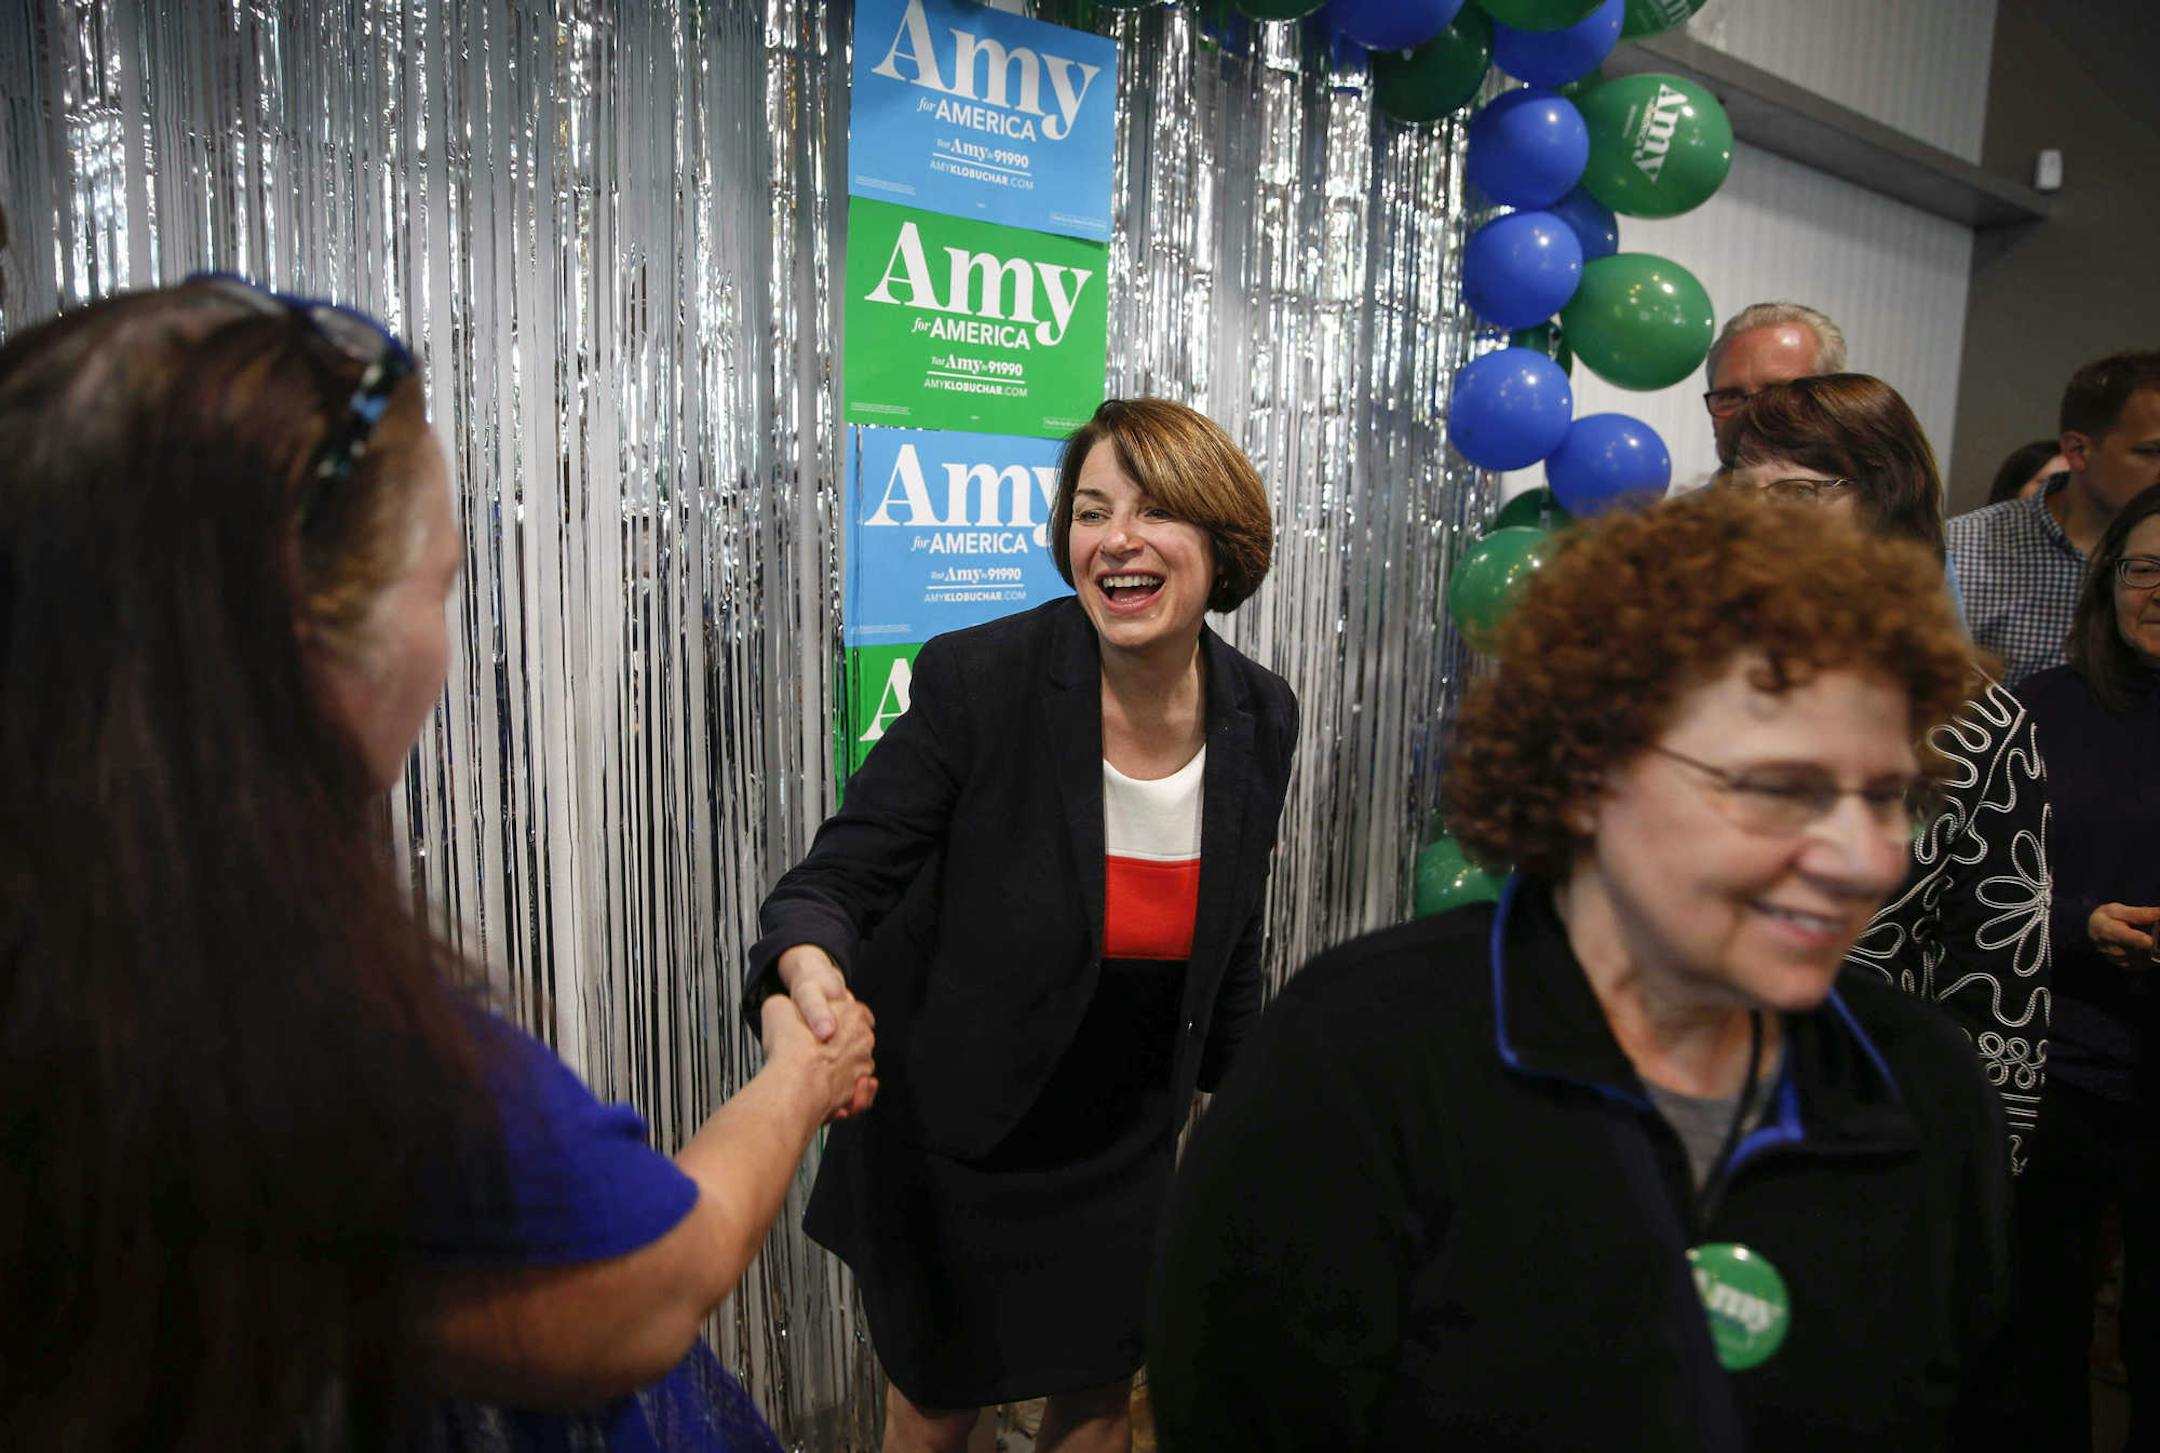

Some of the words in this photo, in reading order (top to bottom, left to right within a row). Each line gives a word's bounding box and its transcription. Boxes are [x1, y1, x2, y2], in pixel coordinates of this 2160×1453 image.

[871, 0, 1101, 141] Amy
[916, 96, 936, 113] for
[935, 98, 1037, 143] AMERICA
[1632, 83, 1688, 184] Amy
[950, 138, 988, 161] Amy
[994, 149, 1029, 169] 91990
[929, 160, 1034, 190] AMYKLOBUCHAR.COM
[864, 221, 1093, 347] Amy
[911, 317, 931, 333] for
[930, 317, 1031, 350] AMERICA
[945, 354, 982, 374] Amy
[988, 361, 1024, 377] 91990
[924, 378, 1028, 398] AMYKLOBUCHAR.COM
[911, 535, 929, 552] for
[928, 533, 1029, 555] AMERICA
[944, 567, 982, 584] Amy
[987, 568, 1022, 582] 91990
[923, 591, 1027, 603] AMYKLOBUCHAR.COM
